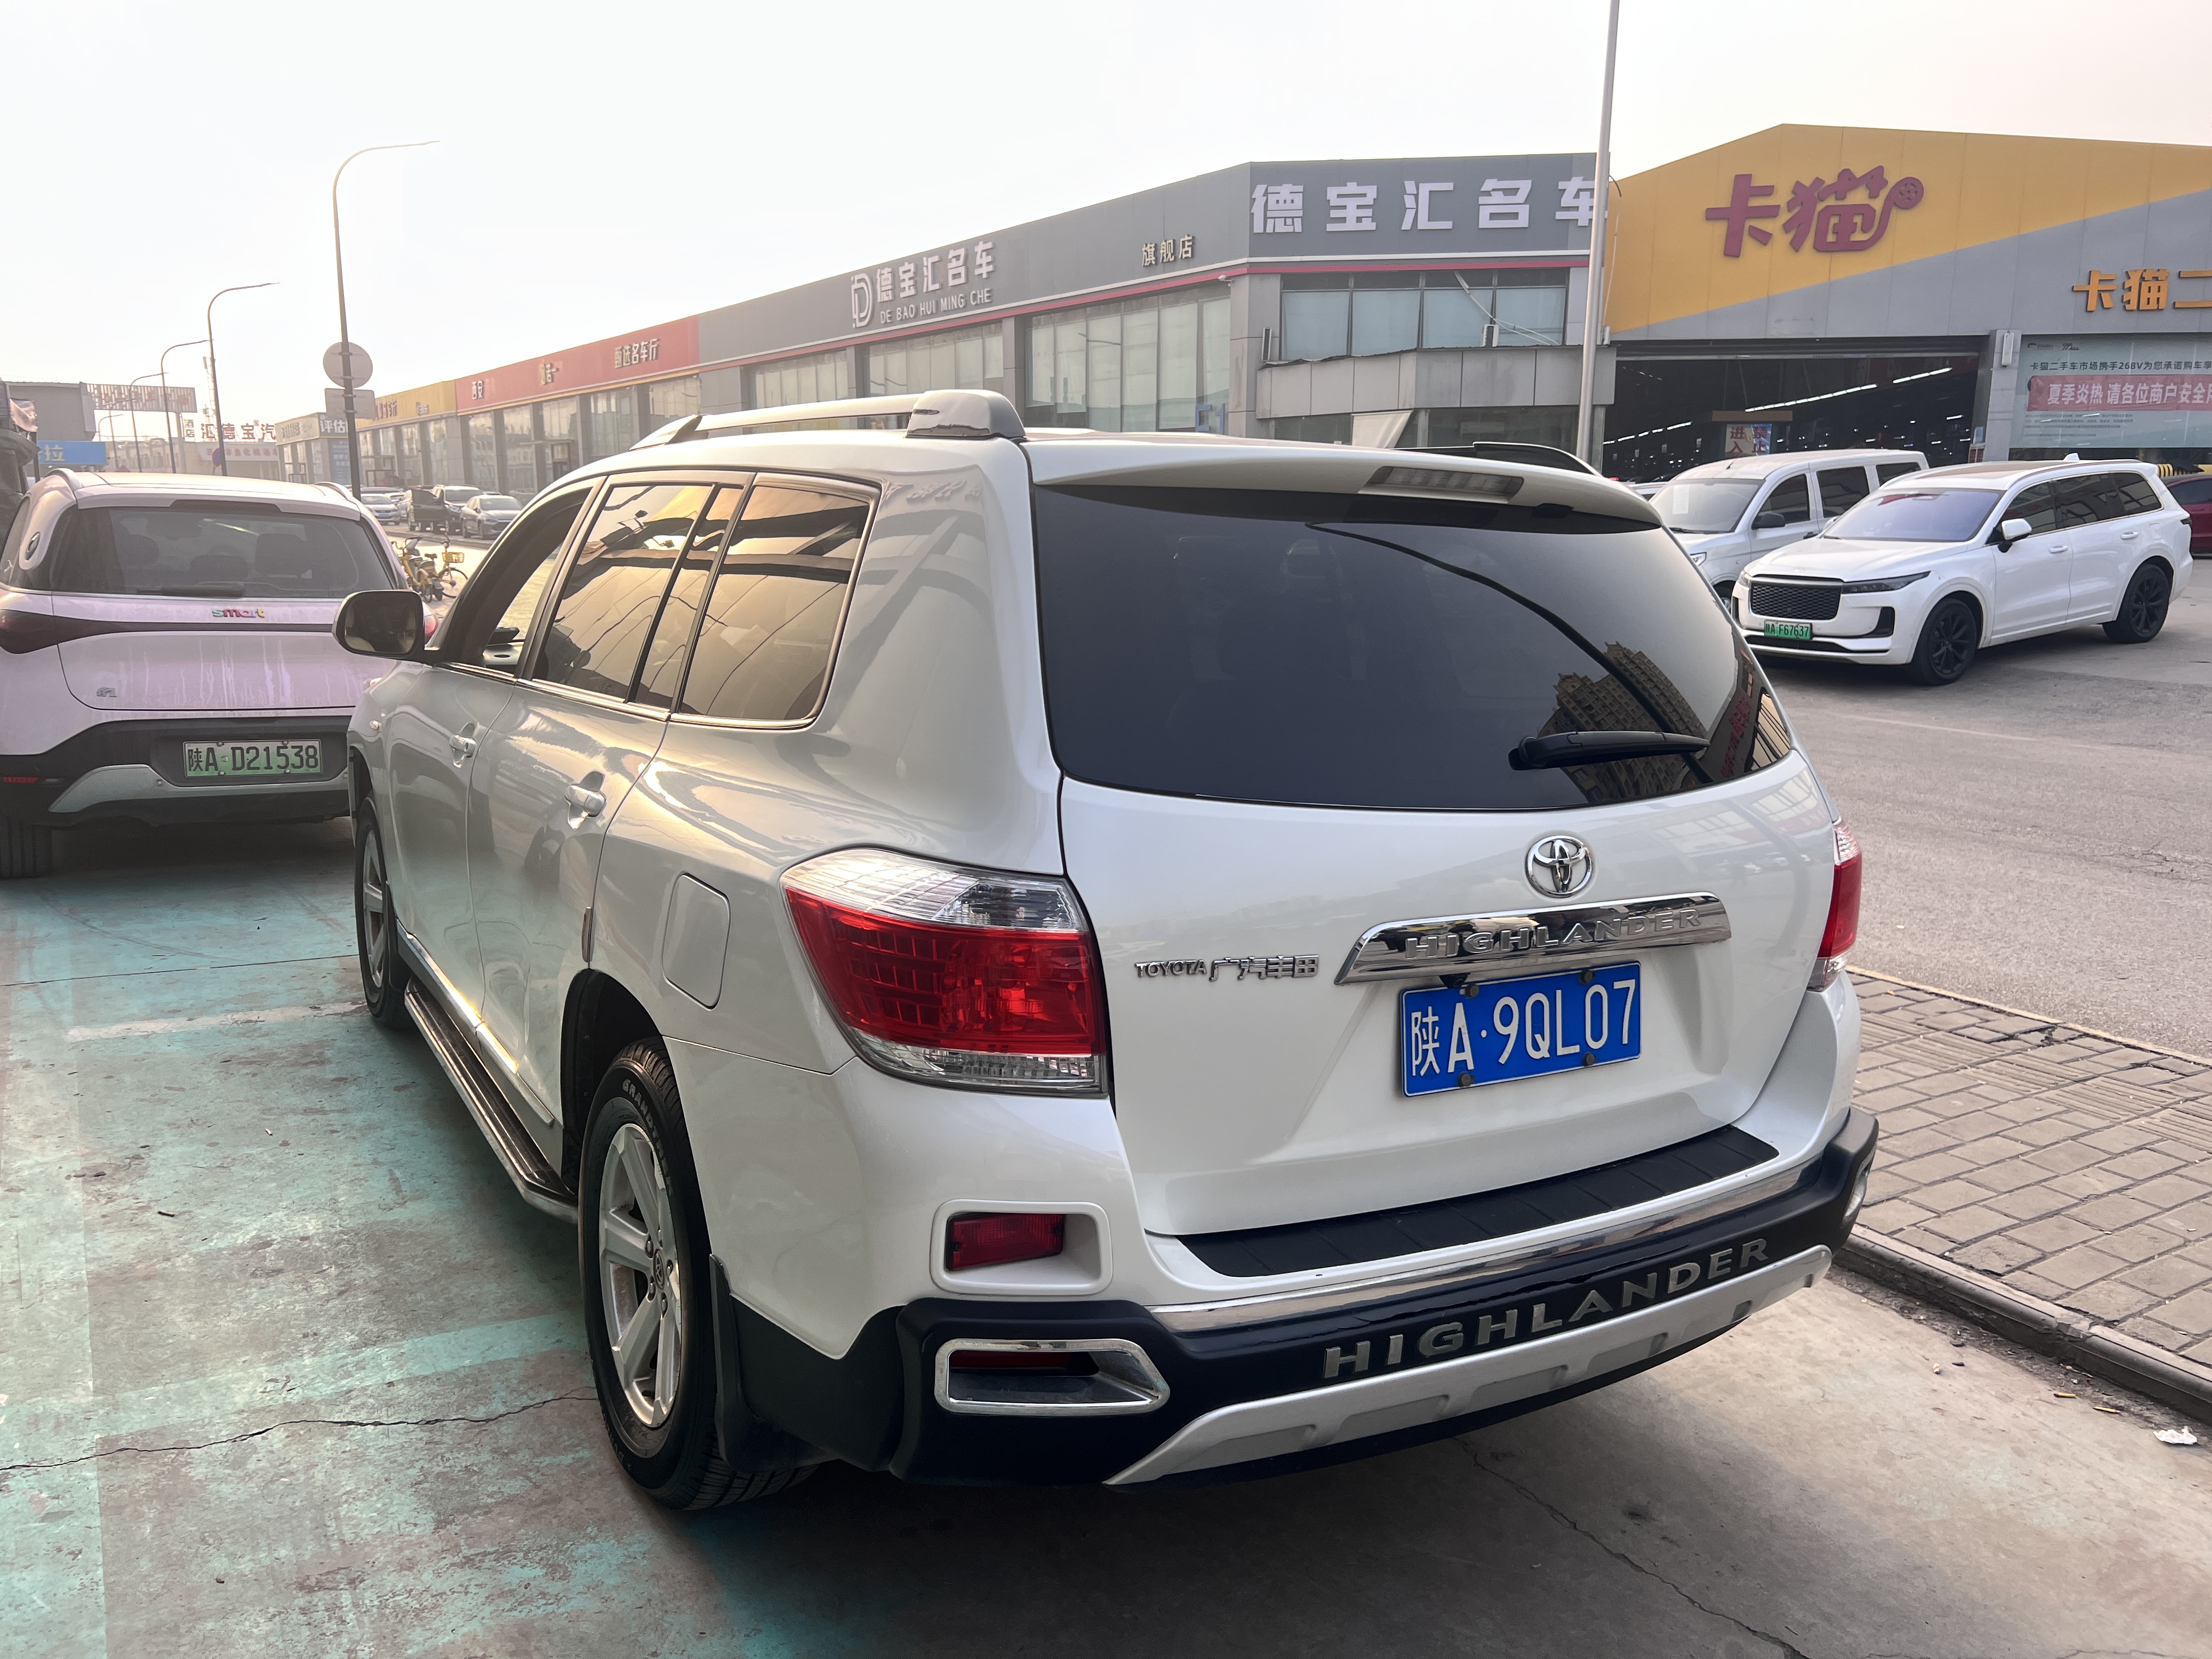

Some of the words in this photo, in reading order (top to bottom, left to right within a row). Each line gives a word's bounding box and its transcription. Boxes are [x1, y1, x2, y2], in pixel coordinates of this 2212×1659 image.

[1251, 176, 1609, 233] 德宝汇名车
[1705, 165, 1926, 258] 卡猫
[1142, 234, 1195, 267] 旗舰店
[876, 241, 995, 302] 德宝汇名车
[2072, 268, 2212, 312] 卡猫二
[879, 309, 893, 324] DE
[896, 303, 916, 321] BAO
[919, 299, 937, 317] HUI
[940, 293, 966, 312] MING
[969, 288, 992, 306] CHE
[2047, 382, 2103, 405] 夏季炎热
[320, 419, 348, 433] 评估
[212, 608, 265, 619] smart
[1404, 909, 1703, 960] HIGHLANDER
[1134, 959, 1207, 978] TOYOTA
[1323, 1238, 1769, 1379] HIGHLANDER
